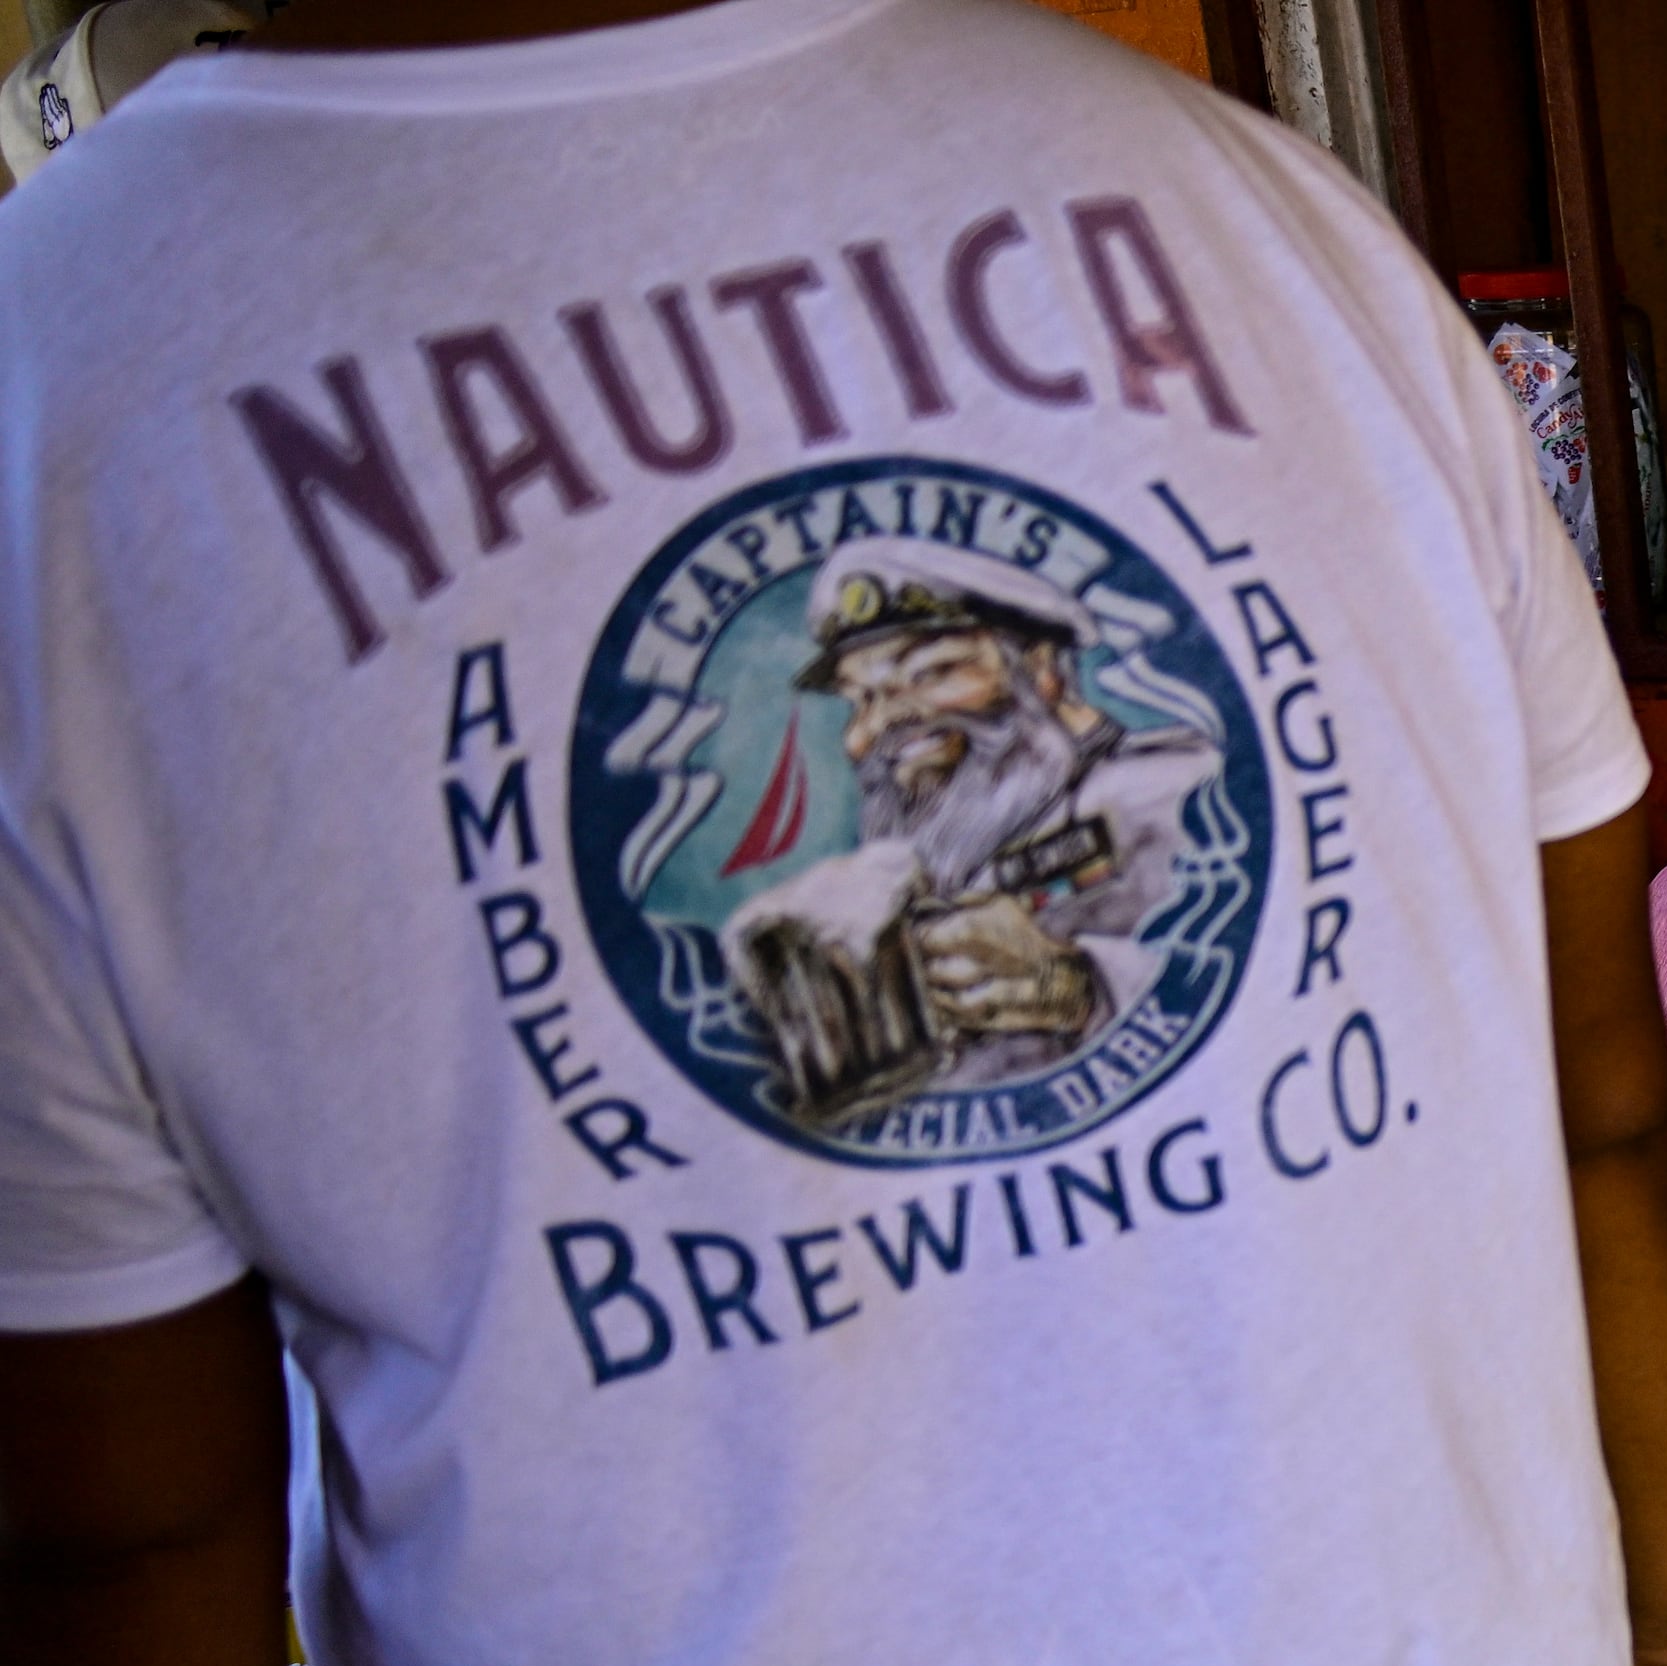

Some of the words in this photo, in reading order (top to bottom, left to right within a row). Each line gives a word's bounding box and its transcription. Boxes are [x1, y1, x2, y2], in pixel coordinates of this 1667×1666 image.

[231, 195, 1256, 665] NAUTICA
[650, 481, 1060, 646] CAPTAIN'S
[441, 639, 692, 1181] AMBER
[1148, 480, 1357, 1002] LAGER
[544, 1116, 1227, 1390] BREWING
[1258, 1006, 1421, 1182] CO.
[1054, 996, 1191, 1123] DARK
